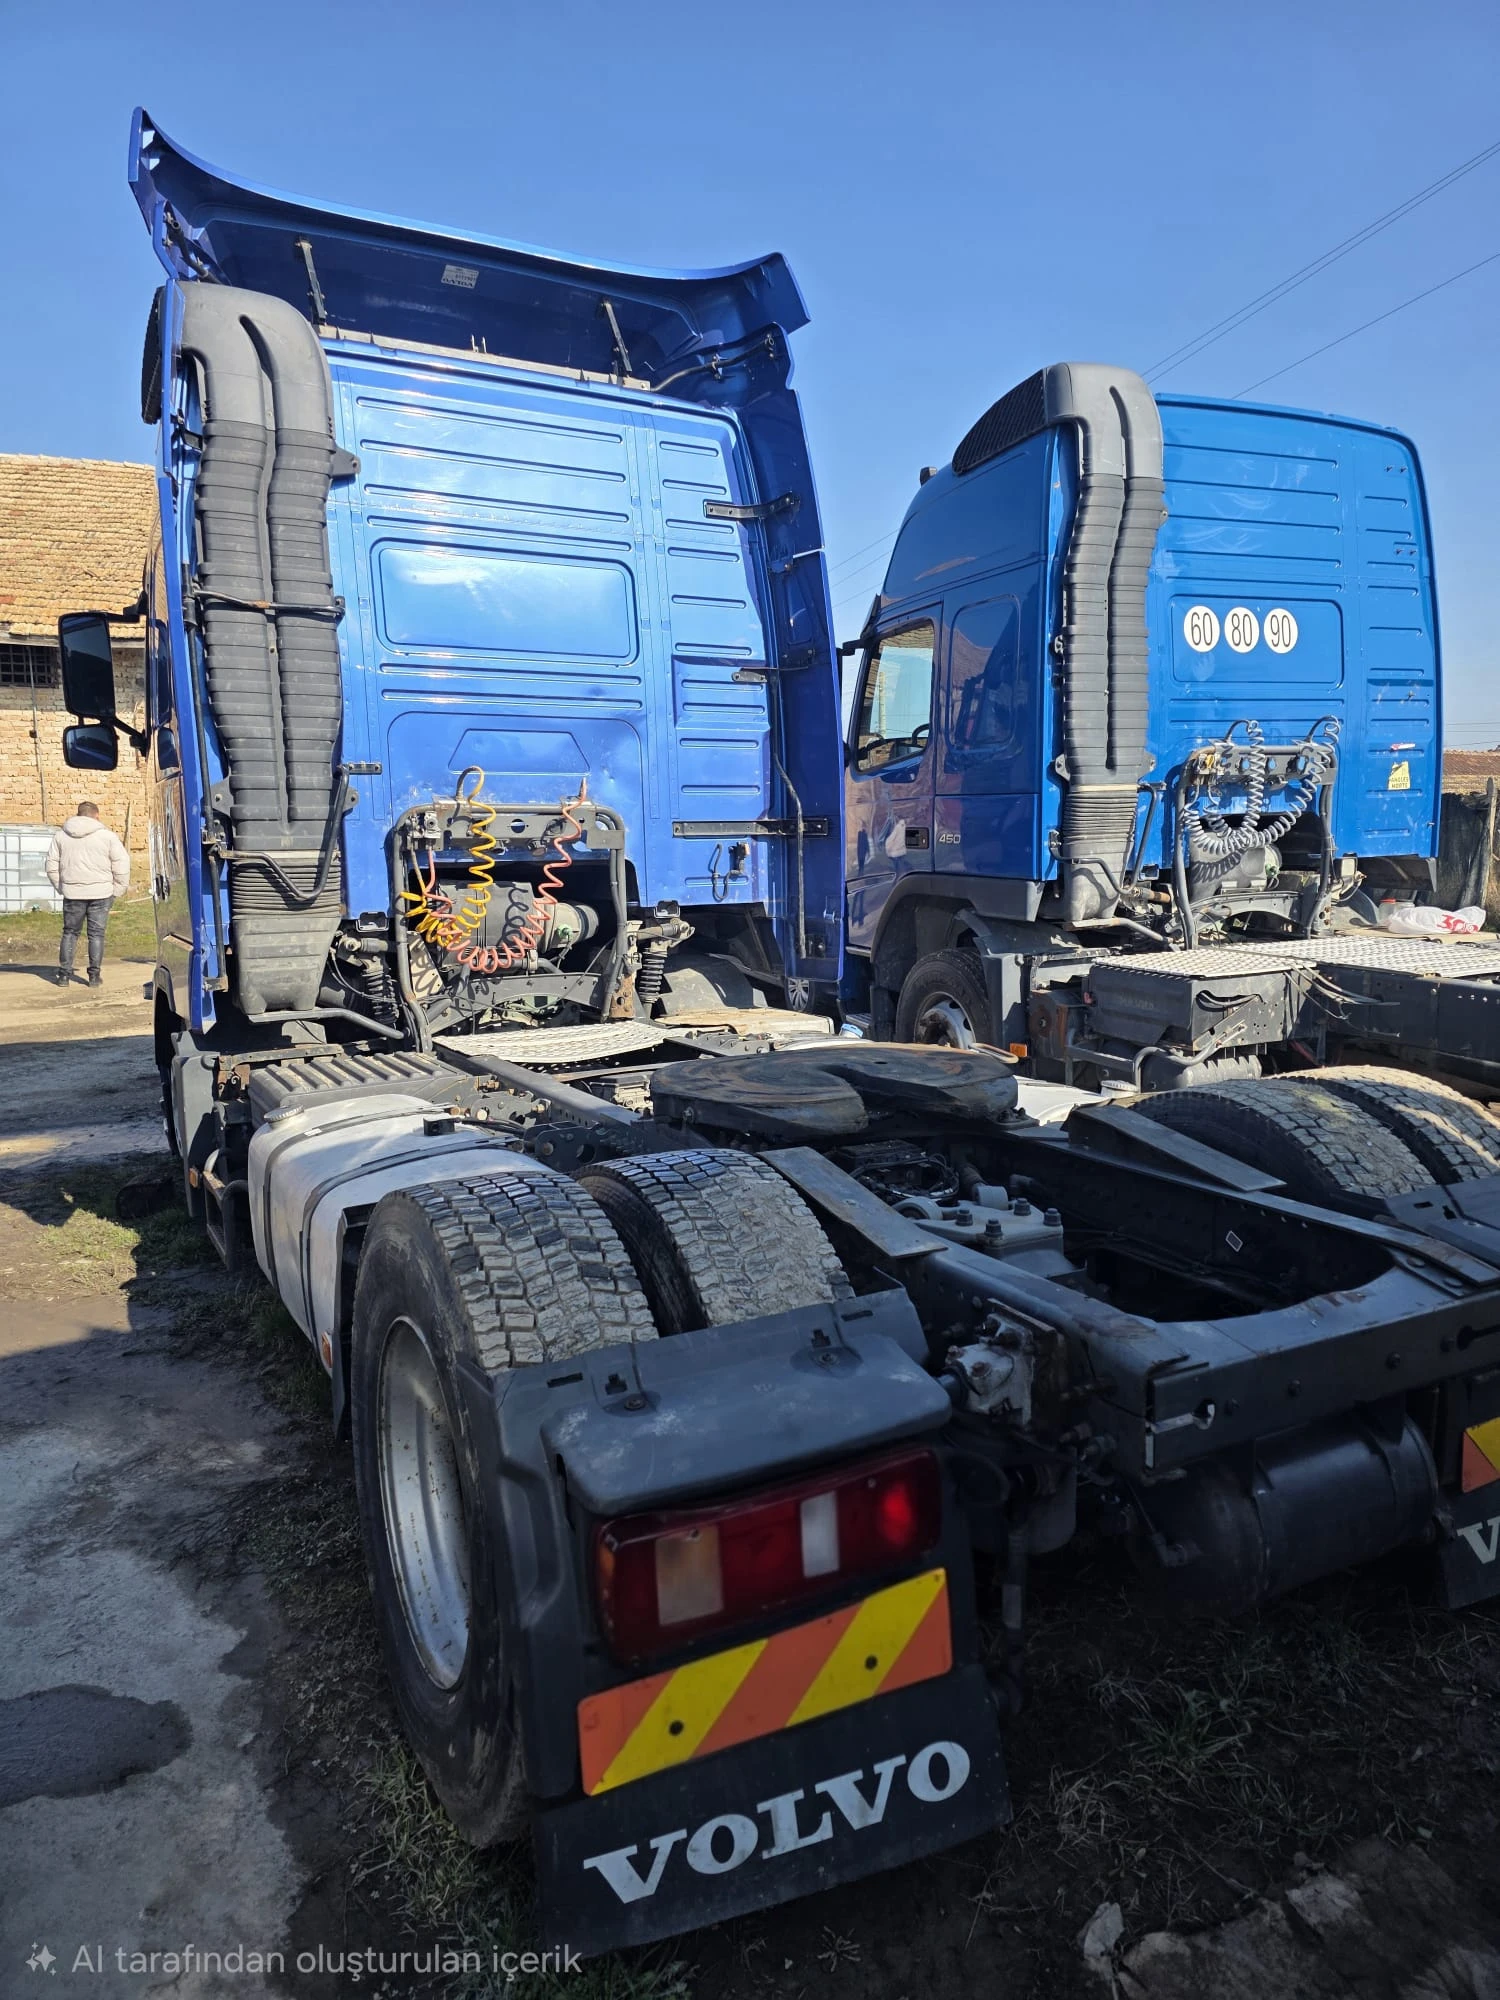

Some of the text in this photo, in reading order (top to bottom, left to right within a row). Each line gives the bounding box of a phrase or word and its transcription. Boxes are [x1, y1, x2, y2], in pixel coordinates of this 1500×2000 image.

[1190, 612, 1292, 648] 60 80 90
[939, 833, 961, 844] 450
[583, 1741, 971, 1905] VOLVO
